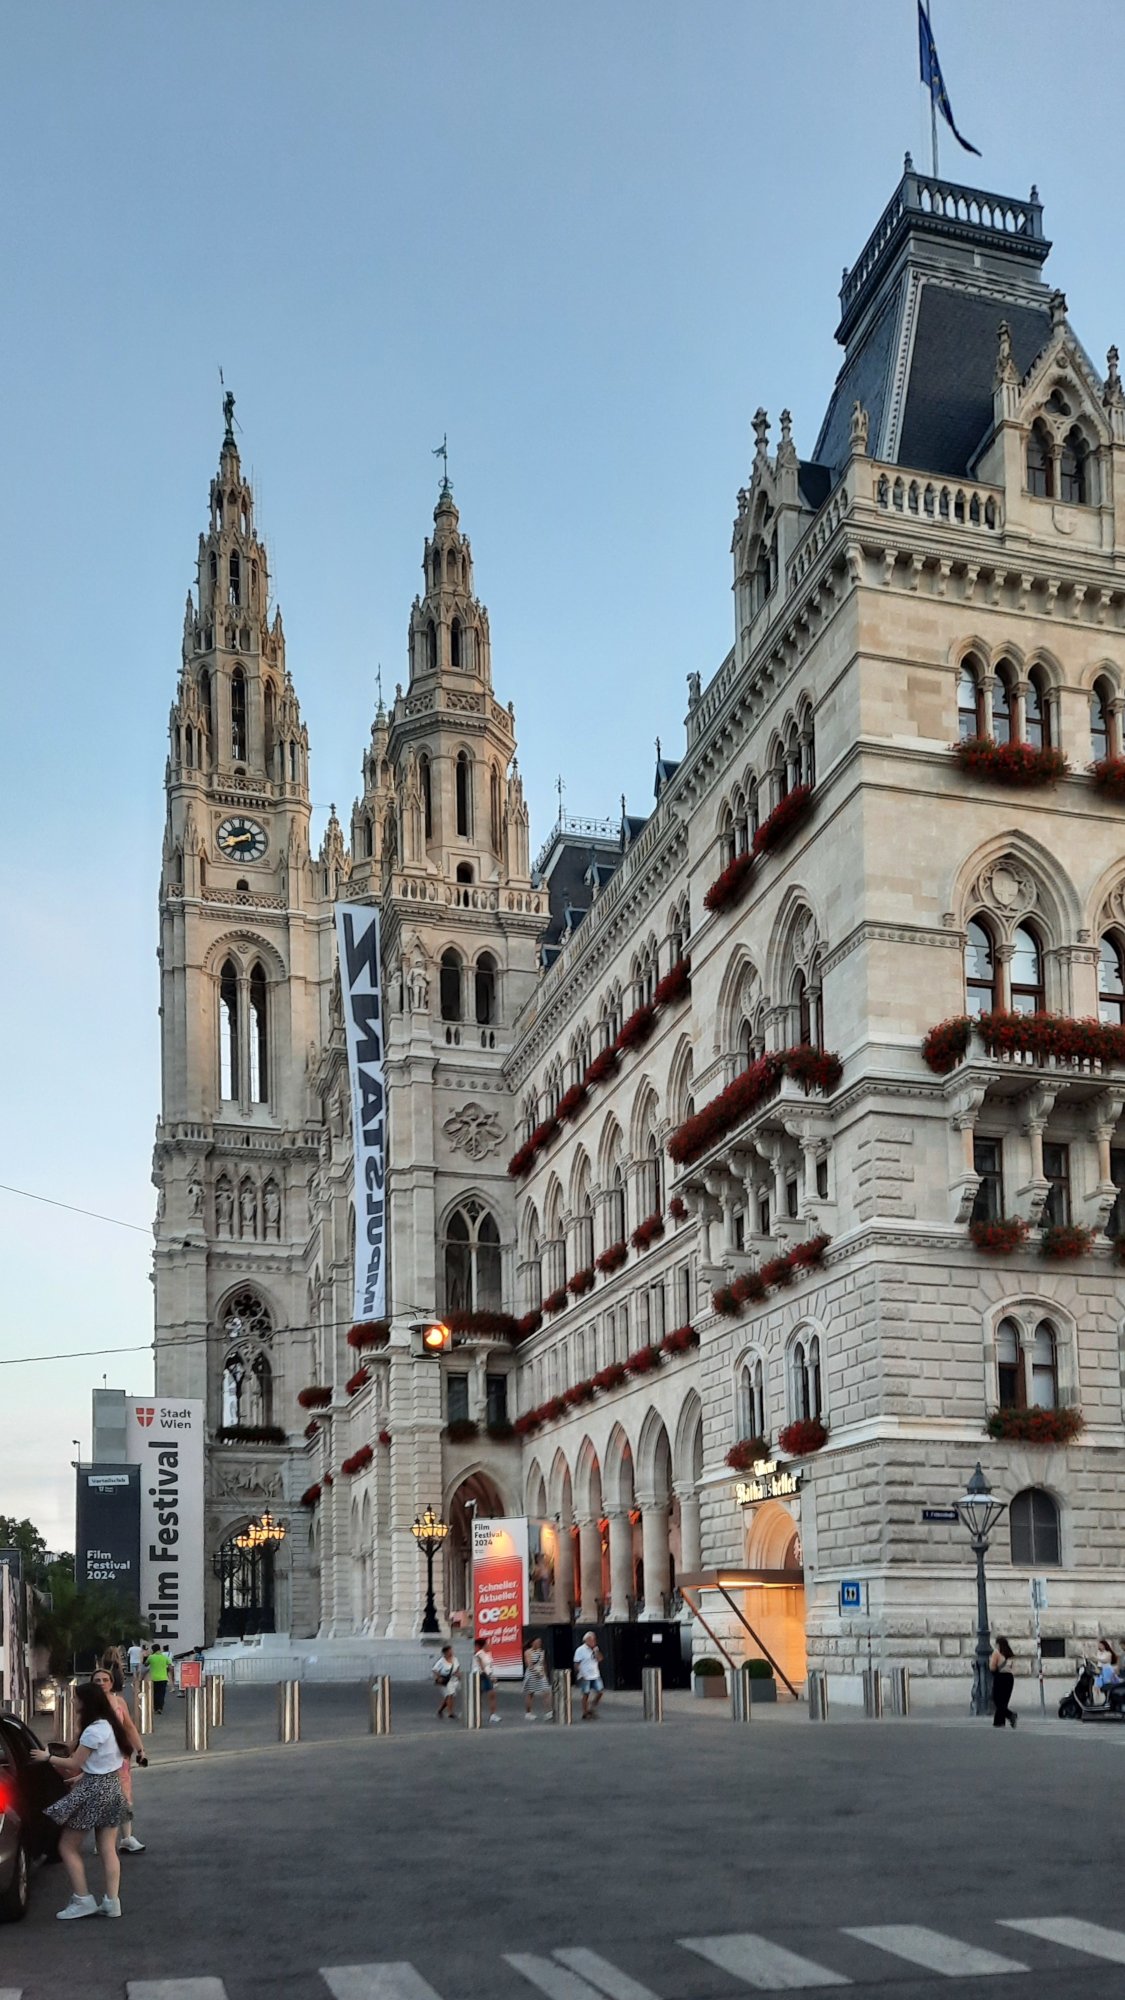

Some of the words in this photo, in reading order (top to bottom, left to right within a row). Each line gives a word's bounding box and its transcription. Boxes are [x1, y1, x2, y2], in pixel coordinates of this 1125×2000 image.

[160, 1408, 192, 1418] Stadt
[160, 1419, 192, 1429] Wien
[148, 1441, 179, 1562] Festival
[474, 1523, 490, 1531] Film
[474, 1530, 503, 1539] Festival
[474, 1539, 493, 1547] 2024
[86, 1550, 112, 1559] Film
[86, 1560, 131, 1570] Festival
[86, 1571, 116, 1580] 2024
[478, 1580, 519, 1593] Schneller.
[478, 1591, 518, 1604] Aktueller.
[148, 1571, 179, 1639] Film
[478, 1604, 519, 1624] oe24
